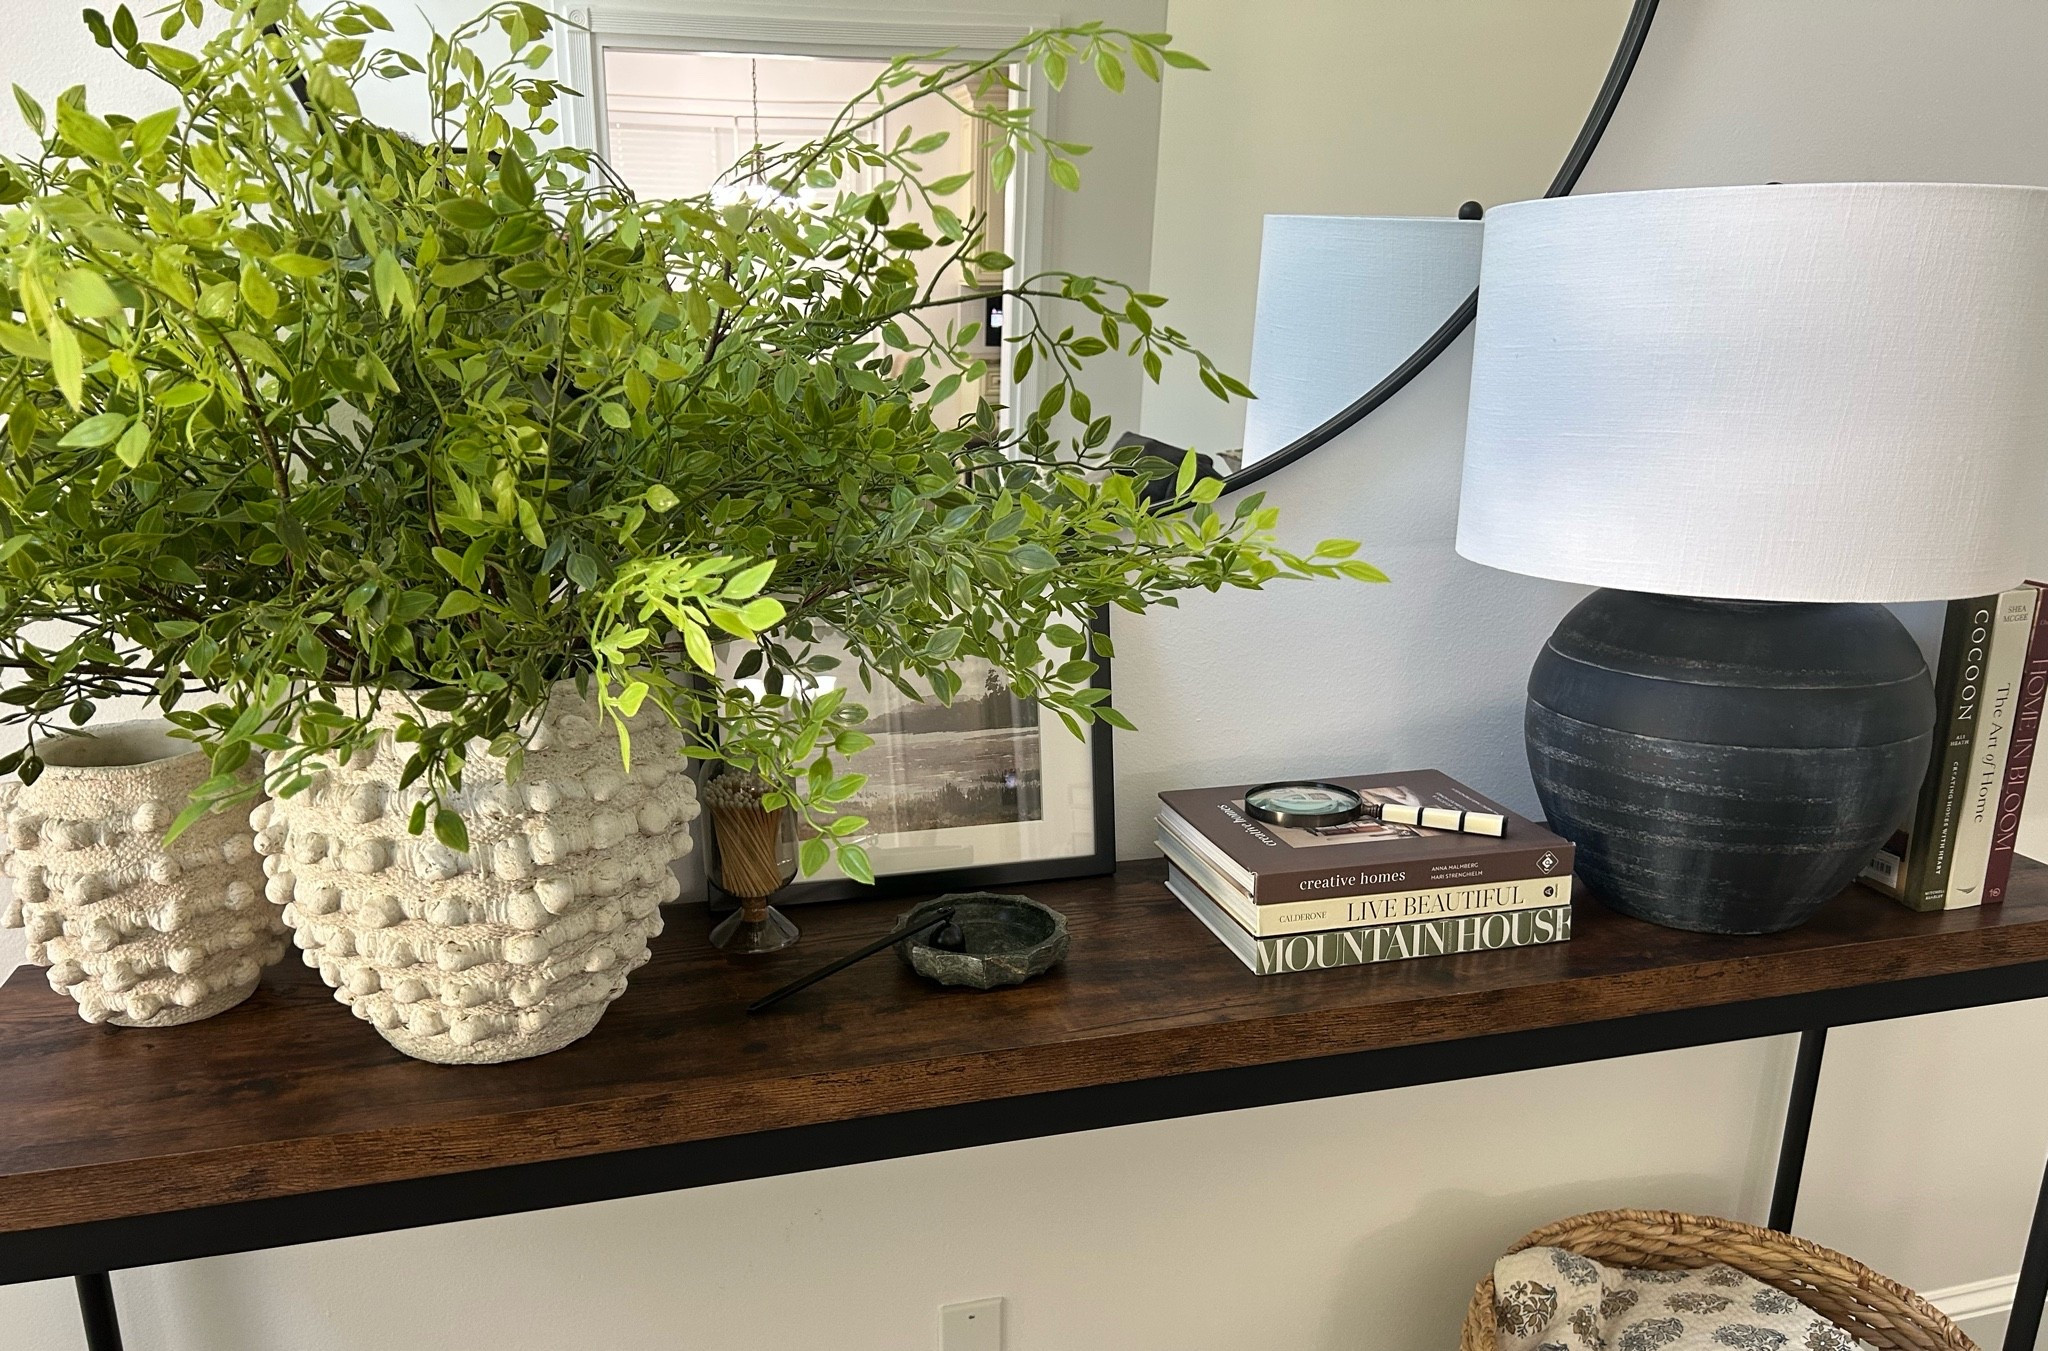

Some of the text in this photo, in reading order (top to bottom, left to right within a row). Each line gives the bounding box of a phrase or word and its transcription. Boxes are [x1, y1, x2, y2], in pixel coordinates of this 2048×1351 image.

[2008, 605, 2027, 613] SHEA
[1957, 609, 1989, 720] COCOON
[1974, 682, 2011, 823] The Art of Home
[1995, 659, 2048, 851] HOME IN BLOOM
[1217, 804, 1277, 847] creative homes
[1935, 761, 1959, 874] CREATING HOMES WITH HEART
[1299, 870, 1406, 891] creative homes
[1448, 862, 1479, 870] MALMBERG
[1279, 911, 1327, 923] CALDERONE
[1347, 898, 1397, 923] LIVE
[1404, 885, 1524, 916] BEAUTIFUL
[1256, 920, 1449, 976] MOUNTAIN
[1454, 905, 1571, 953] HOUSE
